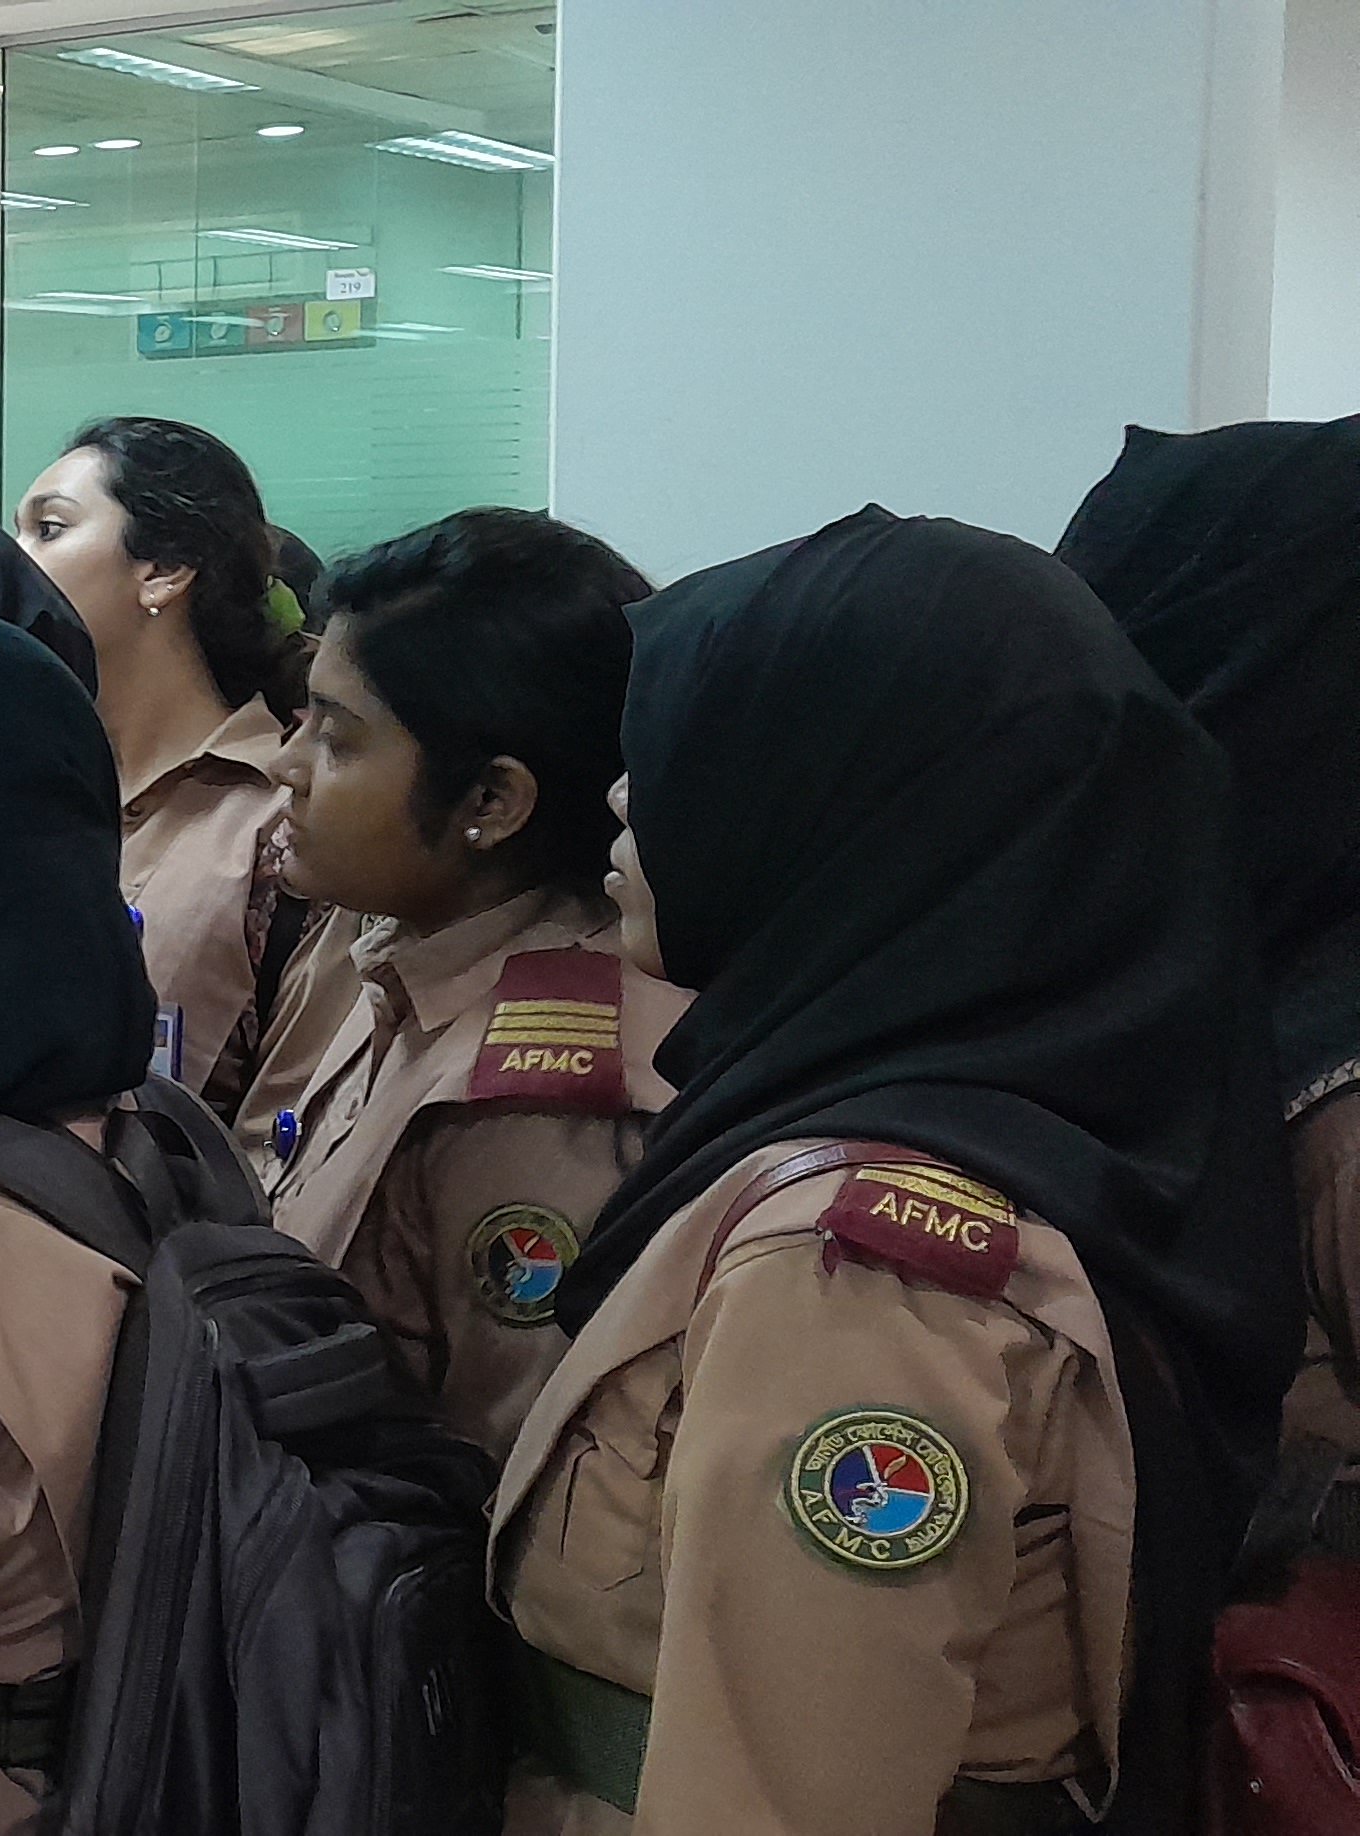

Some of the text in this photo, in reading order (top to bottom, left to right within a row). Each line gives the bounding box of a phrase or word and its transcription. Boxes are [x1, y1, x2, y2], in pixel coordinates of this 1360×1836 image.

[340, 282, 362, 294] 219
[498, 1047, 595, 1076] AFMC
[868, 1191, 993, 1254] AFMC
[800, 1489, 891, 1560] AFMC
